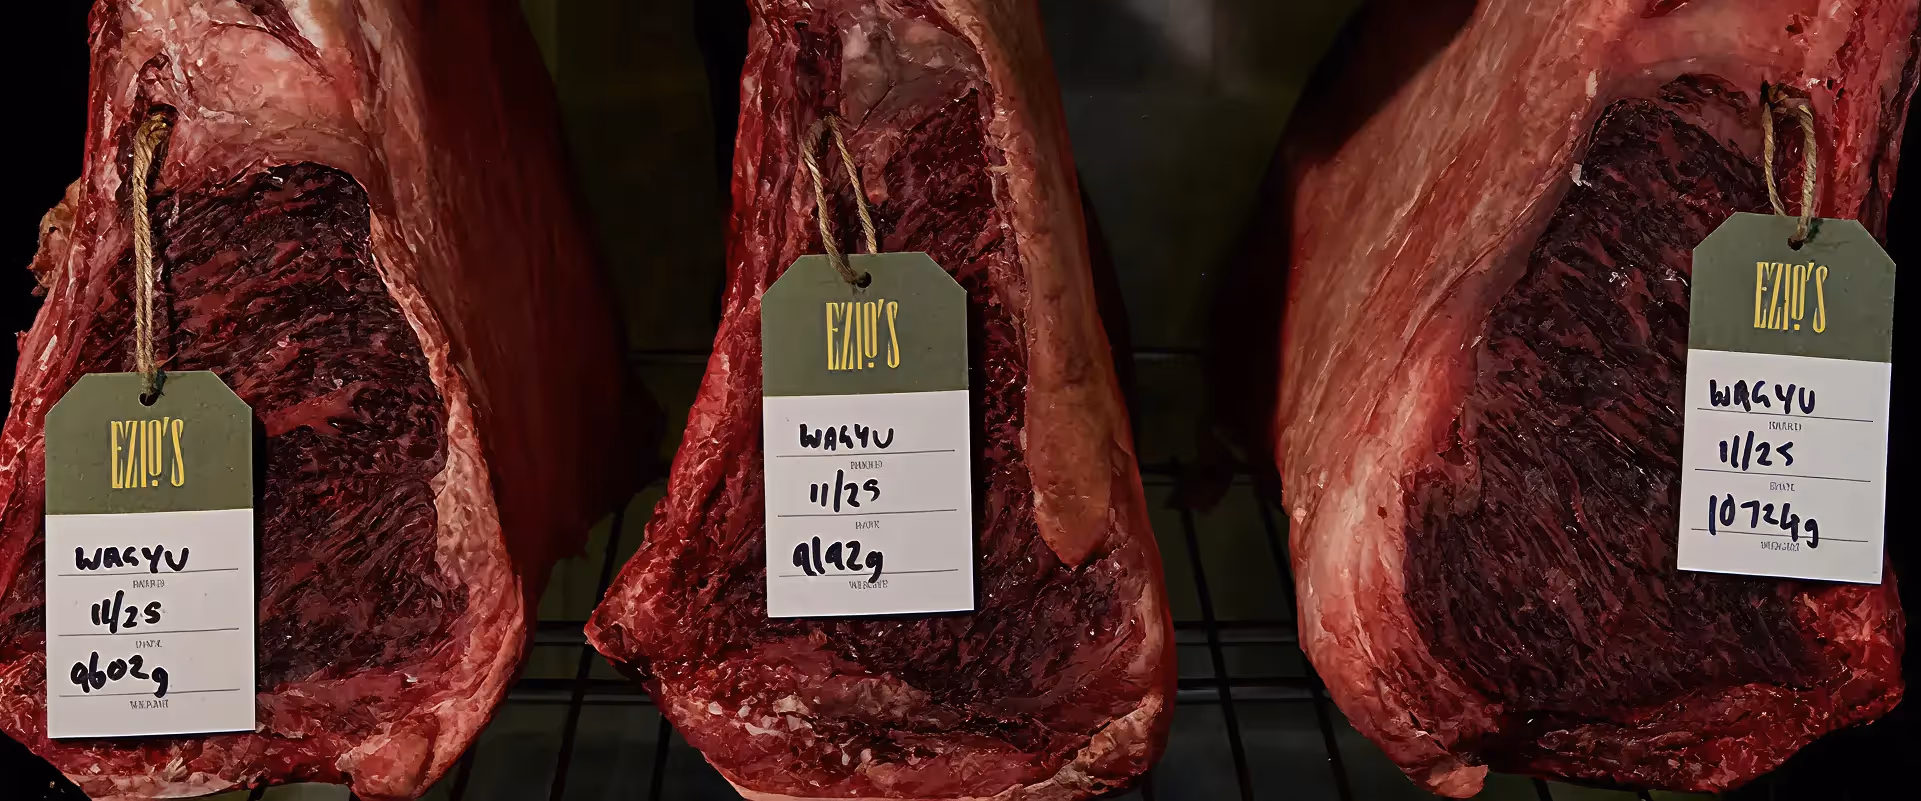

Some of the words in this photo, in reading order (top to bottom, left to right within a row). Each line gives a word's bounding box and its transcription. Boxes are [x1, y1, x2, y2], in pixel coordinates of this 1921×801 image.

[1754, 262, 1828, 333] EZIO'S
[826, 299, 900, 370] EZIO'S
[1709, 379, 1816, 415] WAGYU
[111, 417, 184, 489] EZIO'S
[800, 423, 894, 451] WAGYU
[1719, 430, 1794, 471] 11/25
[810, 469, 881, 513] 11/25
[75, 545, 190, 573] WAGYU
[793, 536, 884, 584] 9192g
[91, 590, 162, 634] 11/25
[70, 651, 169, 698] 9602g
